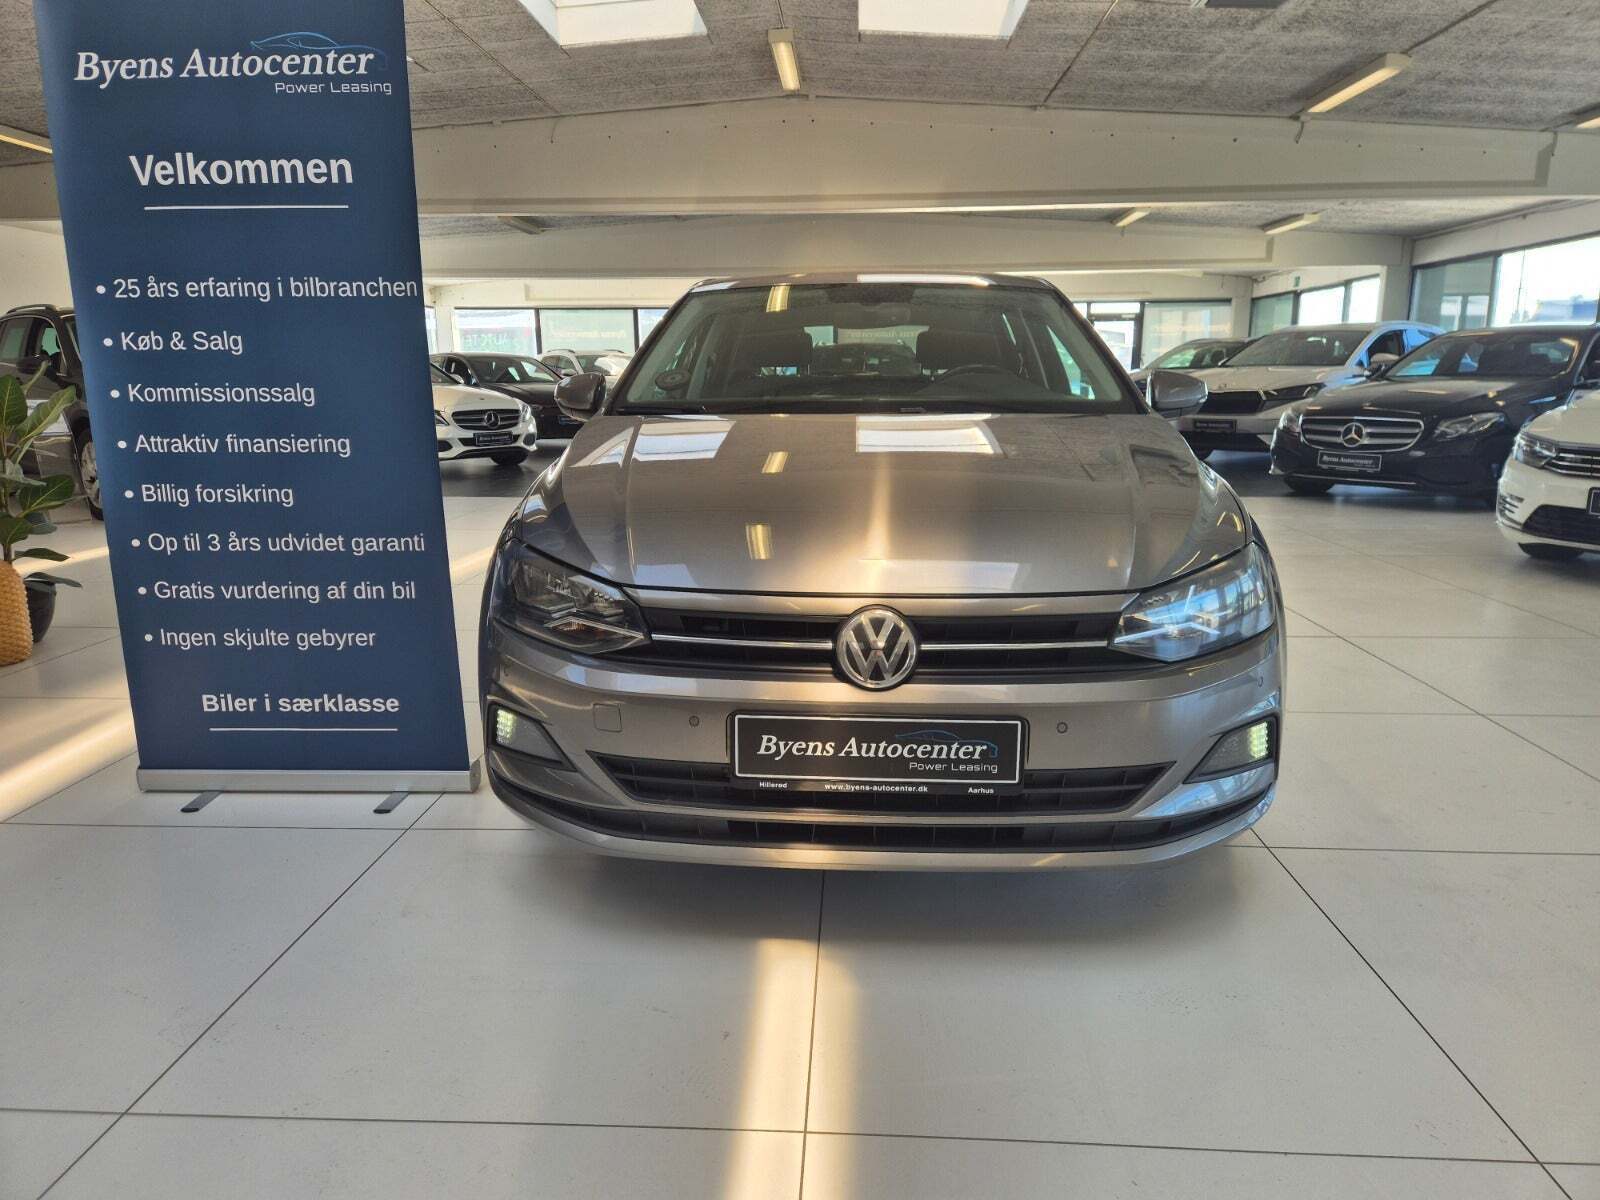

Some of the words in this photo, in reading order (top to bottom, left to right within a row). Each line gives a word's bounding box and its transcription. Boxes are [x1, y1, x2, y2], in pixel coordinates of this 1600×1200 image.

[74, 52, 173, 89] Byens
[180, 47, 374, 77] Autocenter
[275, 83, 324, 93] Power
[331, 82, 391, 95] Leasing
[129, 153, 352, 185] Velkommen
[114, 279, 140, 298] 25
[148, 276, 179, 297] års
[186, 277, 270, 302] erfaring
[278, 277, 282, 296] i
[290, 277, 417, 297] bilbranchen
[121, 331, 163, 350] Køb
[171, 332, 186, 350] &
[193, 331, 242, 355] Salg
[128, 383, 314, 406] Kommissionssalg
[136, 434, 218, 452] Attraktiv
[226, 434, 350, 457] finansiering
[142, 484, 189, 507] Billig
[195, 484, 293, 507] forsikring
[148, 533, 177, 555] Op
[184, 533, 200, 551] til
[208, 534, 220, 551] 3
[229, 531, 260, 551] års
[268, 533, 345, 551] udvidet
[352, 533, 424, 555] garanti
[154, 582, 214, 599] Gratis
[221, 581, 319, 603] vurdering
[328, 582, 346, 599] af
[354, 582, 384, 599] din
[392, 581, 415, 599] bil
[161, 629, 216, 650] Ingen
[224, 629, 289, 650] skjulte
[297, 629, 375, 650] gebyrer
[202, 694, 256, 711] Biler
[265, 694, 270, 711] i
[279, 694, 399, 712] særklasse
[757, 735, 835, 760] Byens
[838, 737, 987, 759] Autocenter
[910, 762, 947, 770] Power
[952, 763, 997, 773] Leasing
[823, 782, 929, 793] www.byens-autocenter.dk
[967, 786, 995, 795] Aarhus
